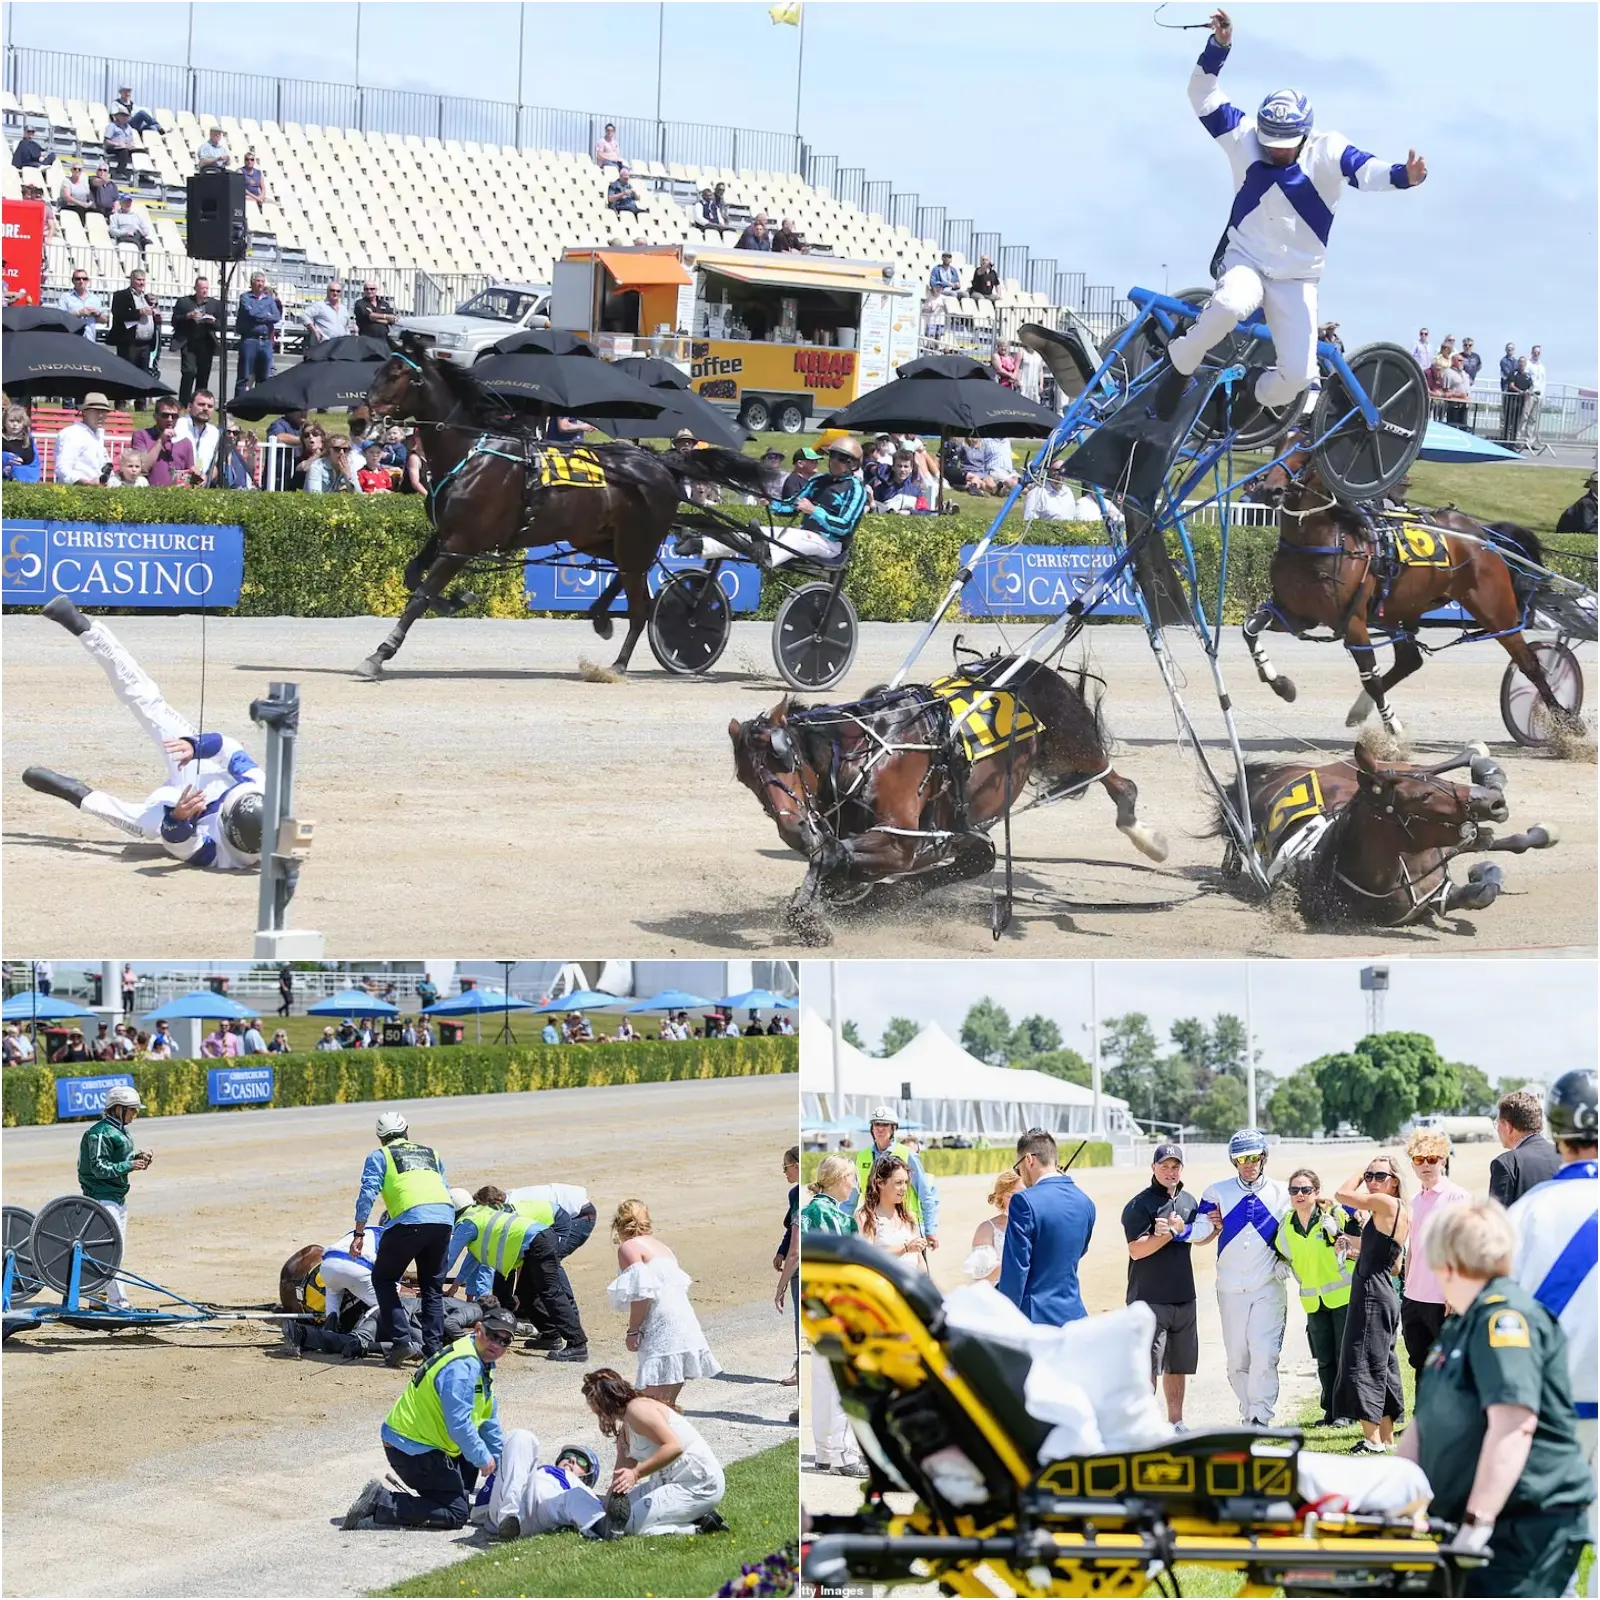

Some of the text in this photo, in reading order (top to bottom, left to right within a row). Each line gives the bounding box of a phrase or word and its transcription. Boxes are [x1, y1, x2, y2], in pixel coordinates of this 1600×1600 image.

[28, 363, 103, 373] LINDAUER
[691, 357, 743, 378] offee
[794, 349, 855, 376] KEBAB
[484, 380, 541, 391] NDAUER
[804, 373, 845, 389] KING
[336, 391, 368, 399] LIND
[52, 530, 215, 551] CHRISTCHURCH
[1026, 553, 1118, 569] CHRISTCHU
[51, 558, 214, 596] CASINO
[384, 1029, 401, 1042] 50
[231, 1081, 271, 1100] CASINO
[84, 1092, 107, 1111] CAS
